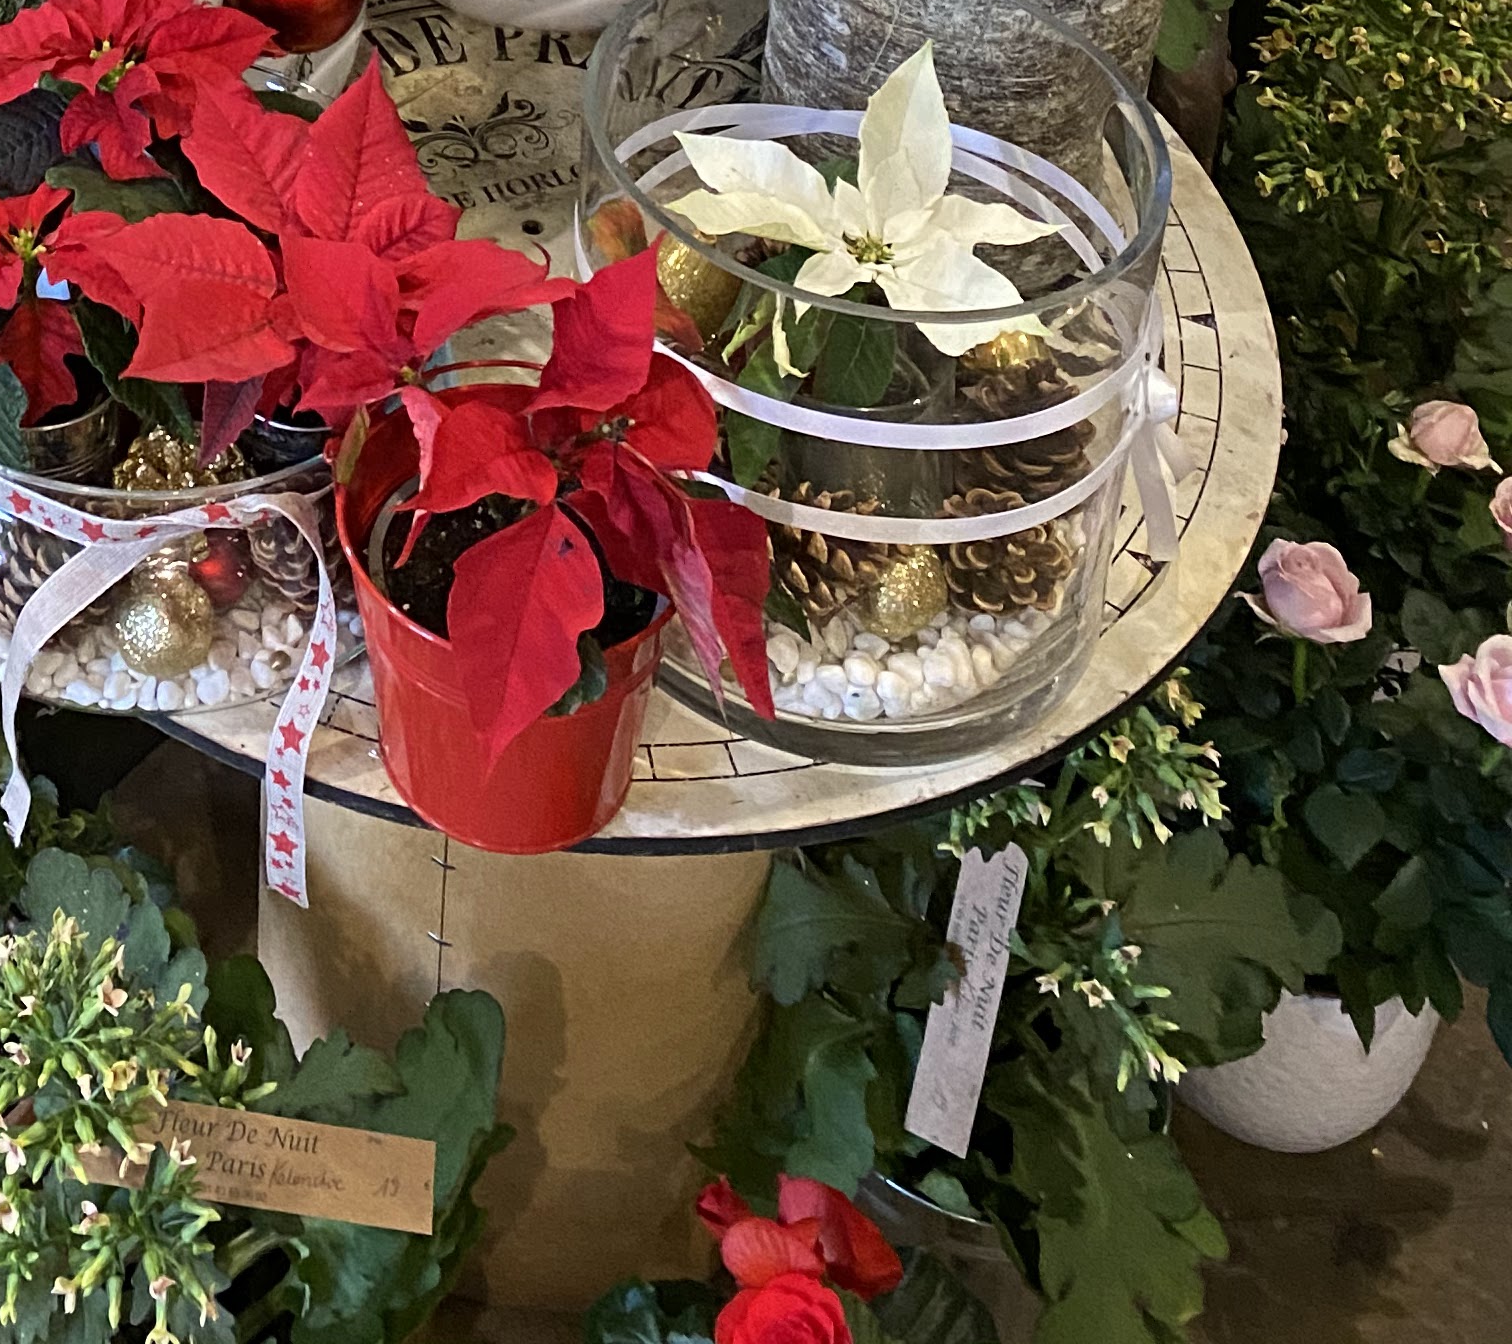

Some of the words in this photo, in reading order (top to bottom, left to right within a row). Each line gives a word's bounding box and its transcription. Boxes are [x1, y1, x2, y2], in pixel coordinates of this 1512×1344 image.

[363, 14, 468, 77] DE
[996, 857, 1019, 926] Fleur
[971, 969, 996, 1031] Nuit
[153, 1110, 220, 1138] Fleur
[226, 1120, 258, 1145] De
[265, 1126, 319, 1154] Nuit
[206, 1150, 267, 1180] Paris
